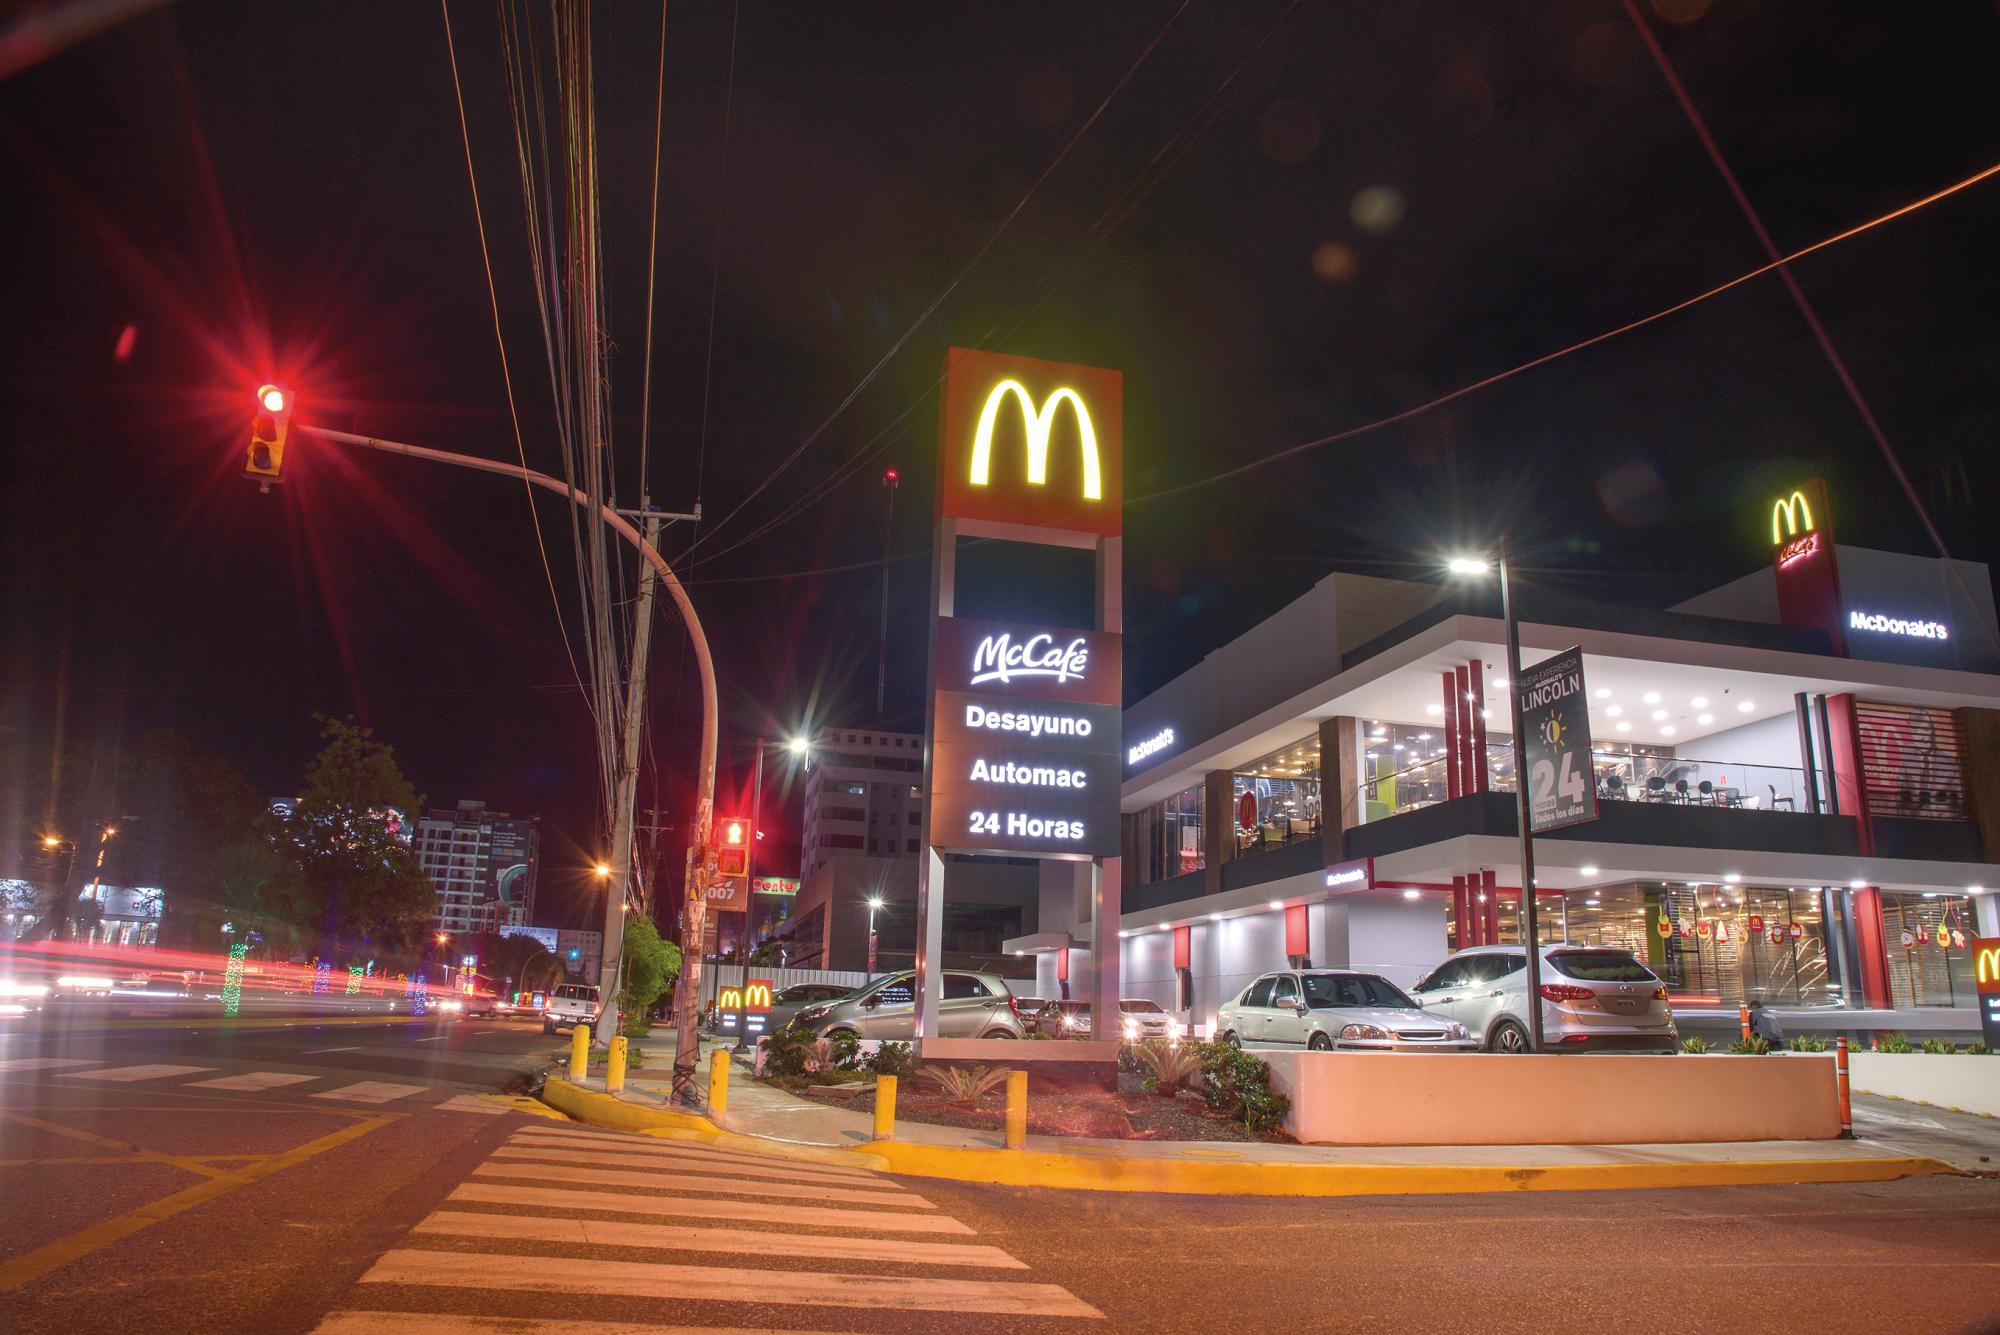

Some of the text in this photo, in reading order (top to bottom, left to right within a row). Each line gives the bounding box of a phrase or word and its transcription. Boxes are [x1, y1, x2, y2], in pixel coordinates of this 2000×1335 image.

[1850, 611, 1948, 640] McDonald's
[971, 634, 1088, 684] McCafé
[1520, 657, 1578, 688] NUEVA EXPERIENCIA
[1521, 673, 1580, 713] LINCOLN
[966, 705, 1092, 736] Desayuno
[1128, 728, 1174, 765] McDonald's
[970, 759, 1087, 788] Automac
[1532, 751, 1585, 803] 24
[1534, 798, 1556, 810] Horas
[1534, 804, 1584, 824] Todos los días
[969, 811, 1085, 839] 24 Horas
